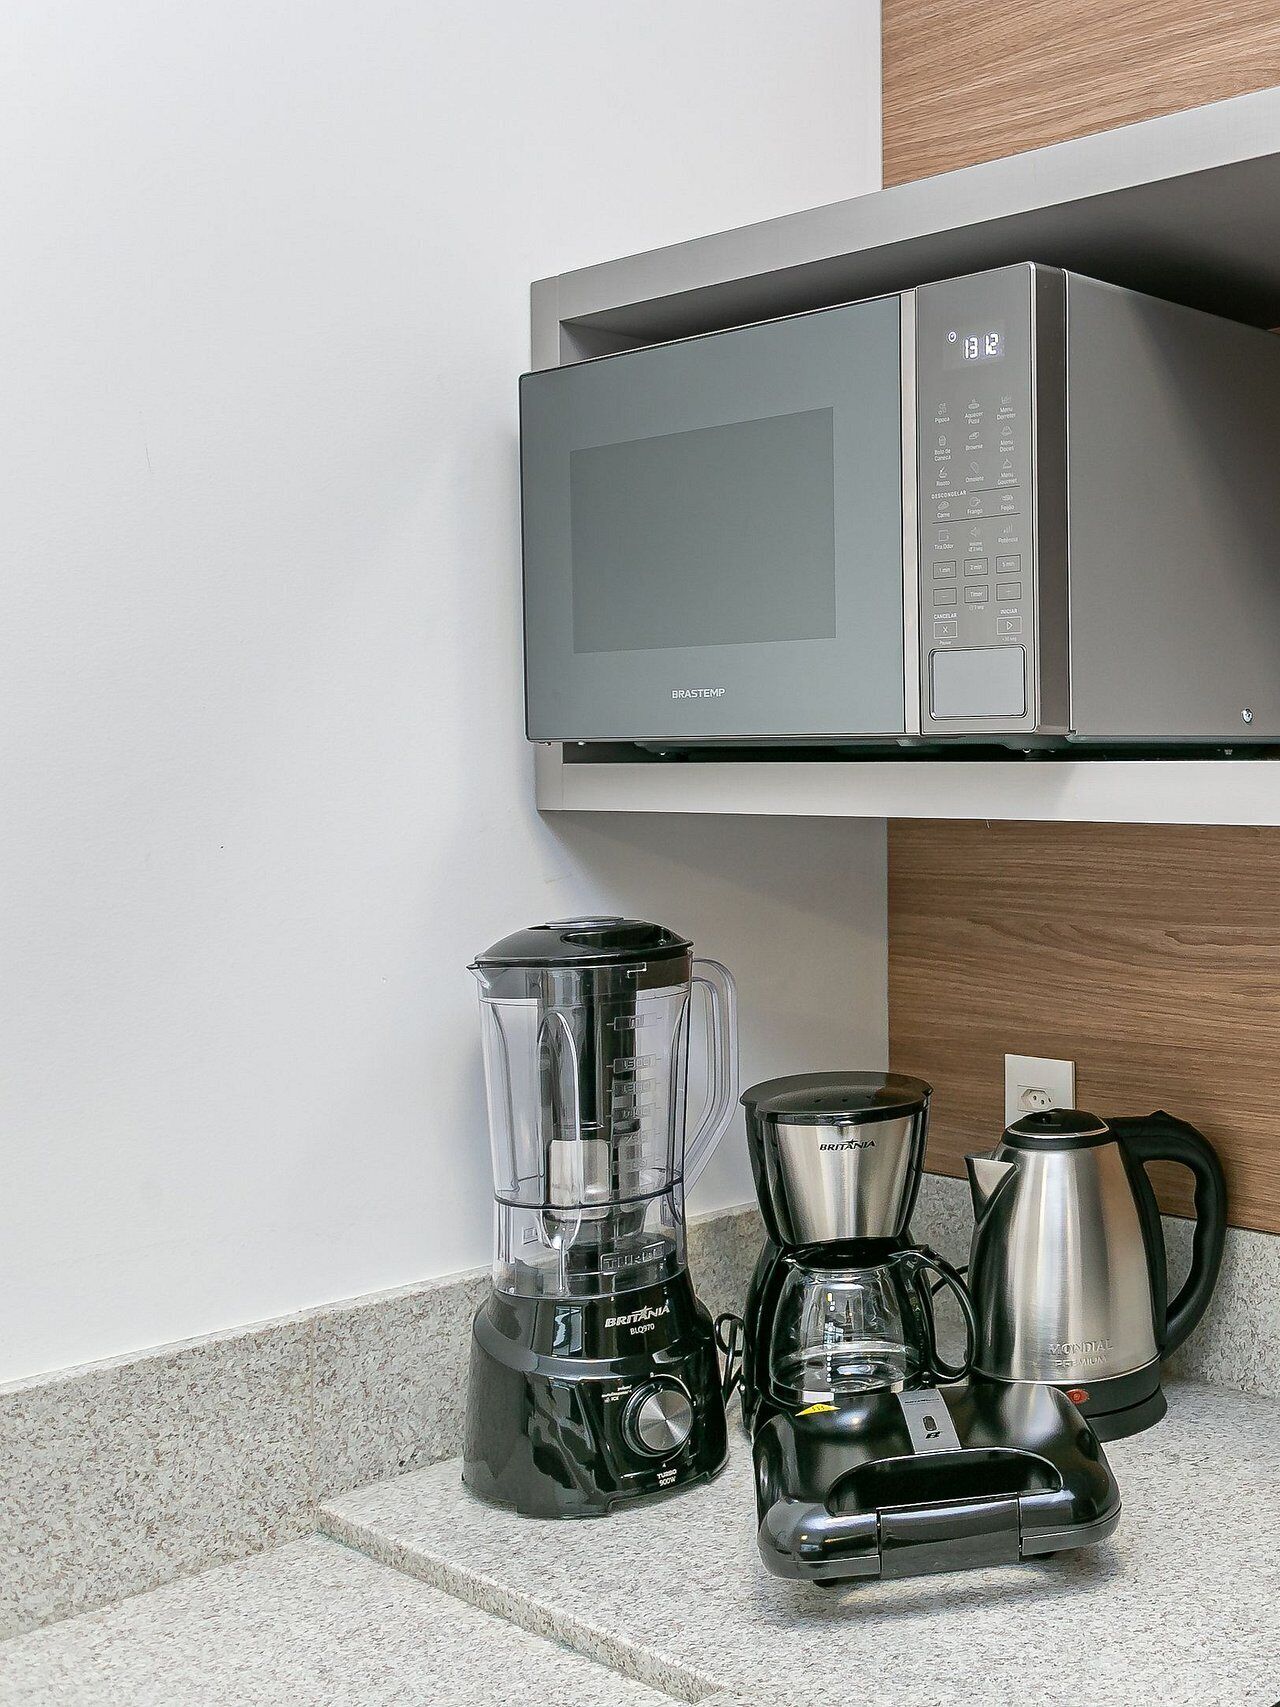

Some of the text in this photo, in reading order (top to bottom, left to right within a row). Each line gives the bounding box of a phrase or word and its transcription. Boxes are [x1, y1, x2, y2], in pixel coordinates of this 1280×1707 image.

[931, 490, 967, 500] DESCONGELAR
[933, 612, 957, 620] CANCELAR
[671, 687, 726, 699] BRASTEMP
[630, 1322, 655, 1335] BLQ970
[656, 1469, 677, 1480] TURBO
